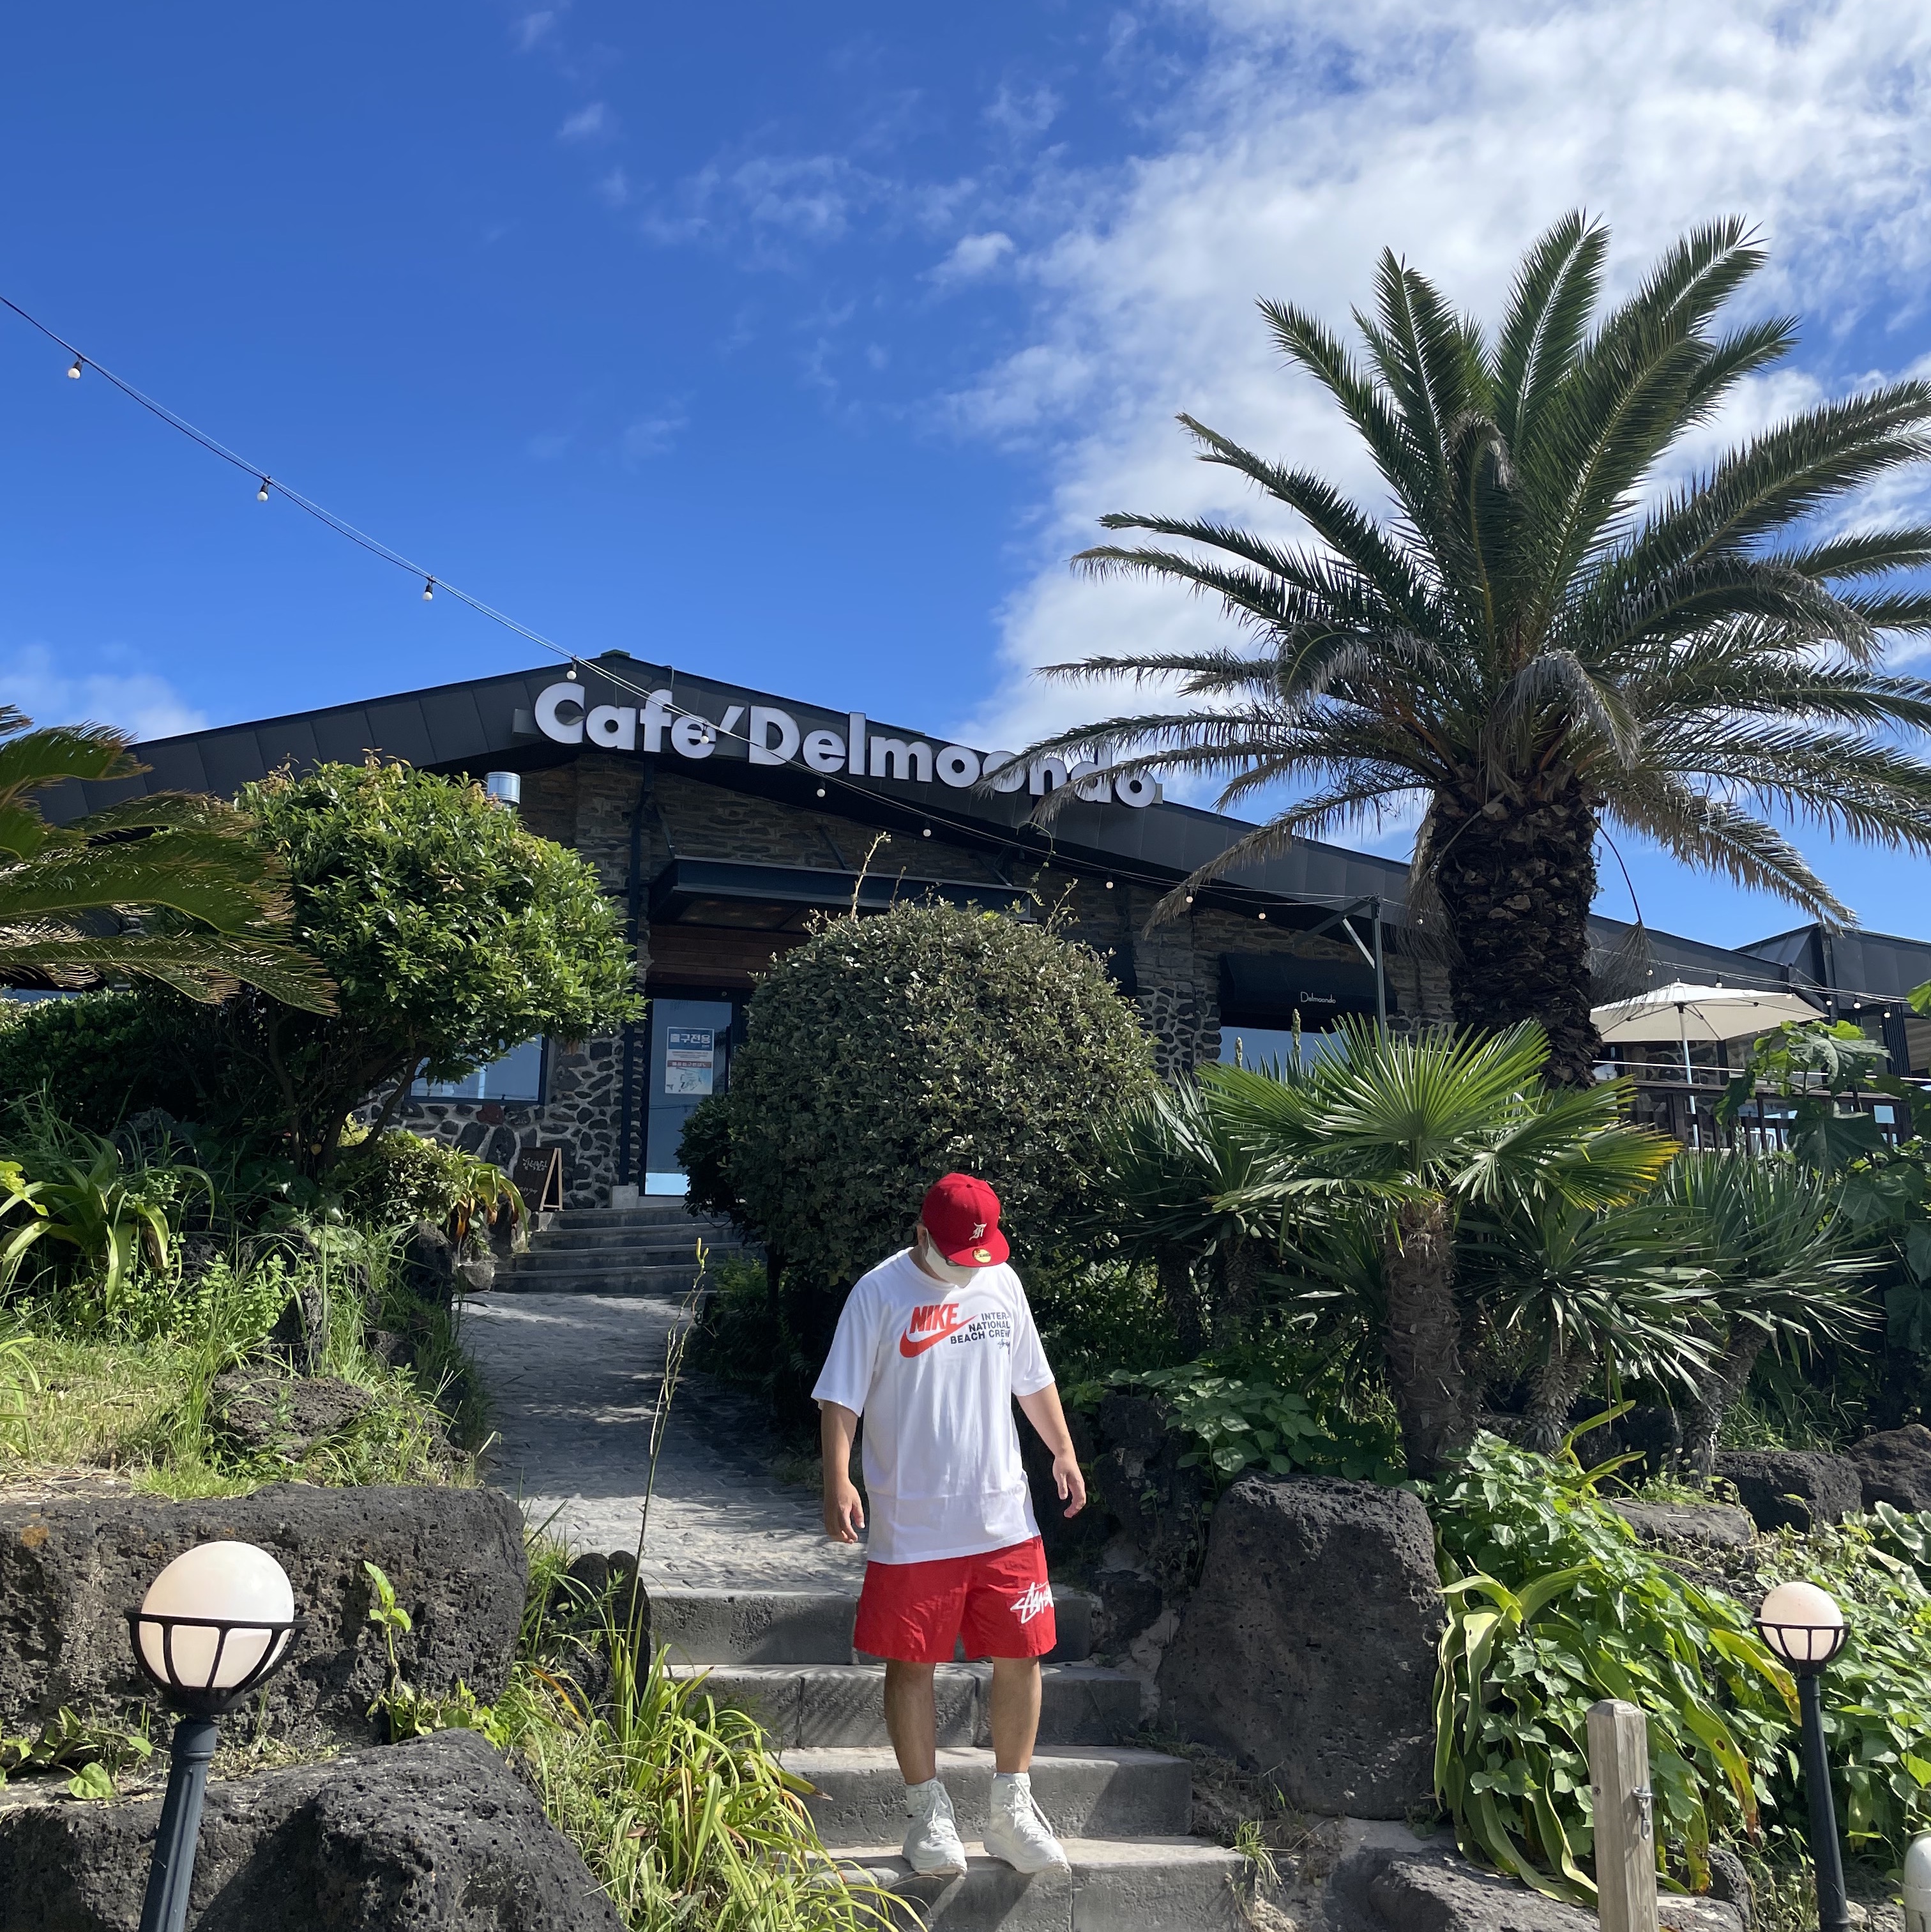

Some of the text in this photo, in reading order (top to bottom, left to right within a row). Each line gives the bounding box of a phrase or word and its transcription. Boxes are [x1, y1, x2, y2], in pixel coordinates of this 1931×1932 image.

[748, 704, 1157, 808] Delmoondo
[1300, 991, 1337, 1004] Delmoondo
[909, 1303, 960, 1334] NIKE
[981, 1312, 1010, 1321] INTER-
[969, 1320, 1011, 1333] NATIONAL
[950, 1329, 1011, 1344] BEACH CREW
